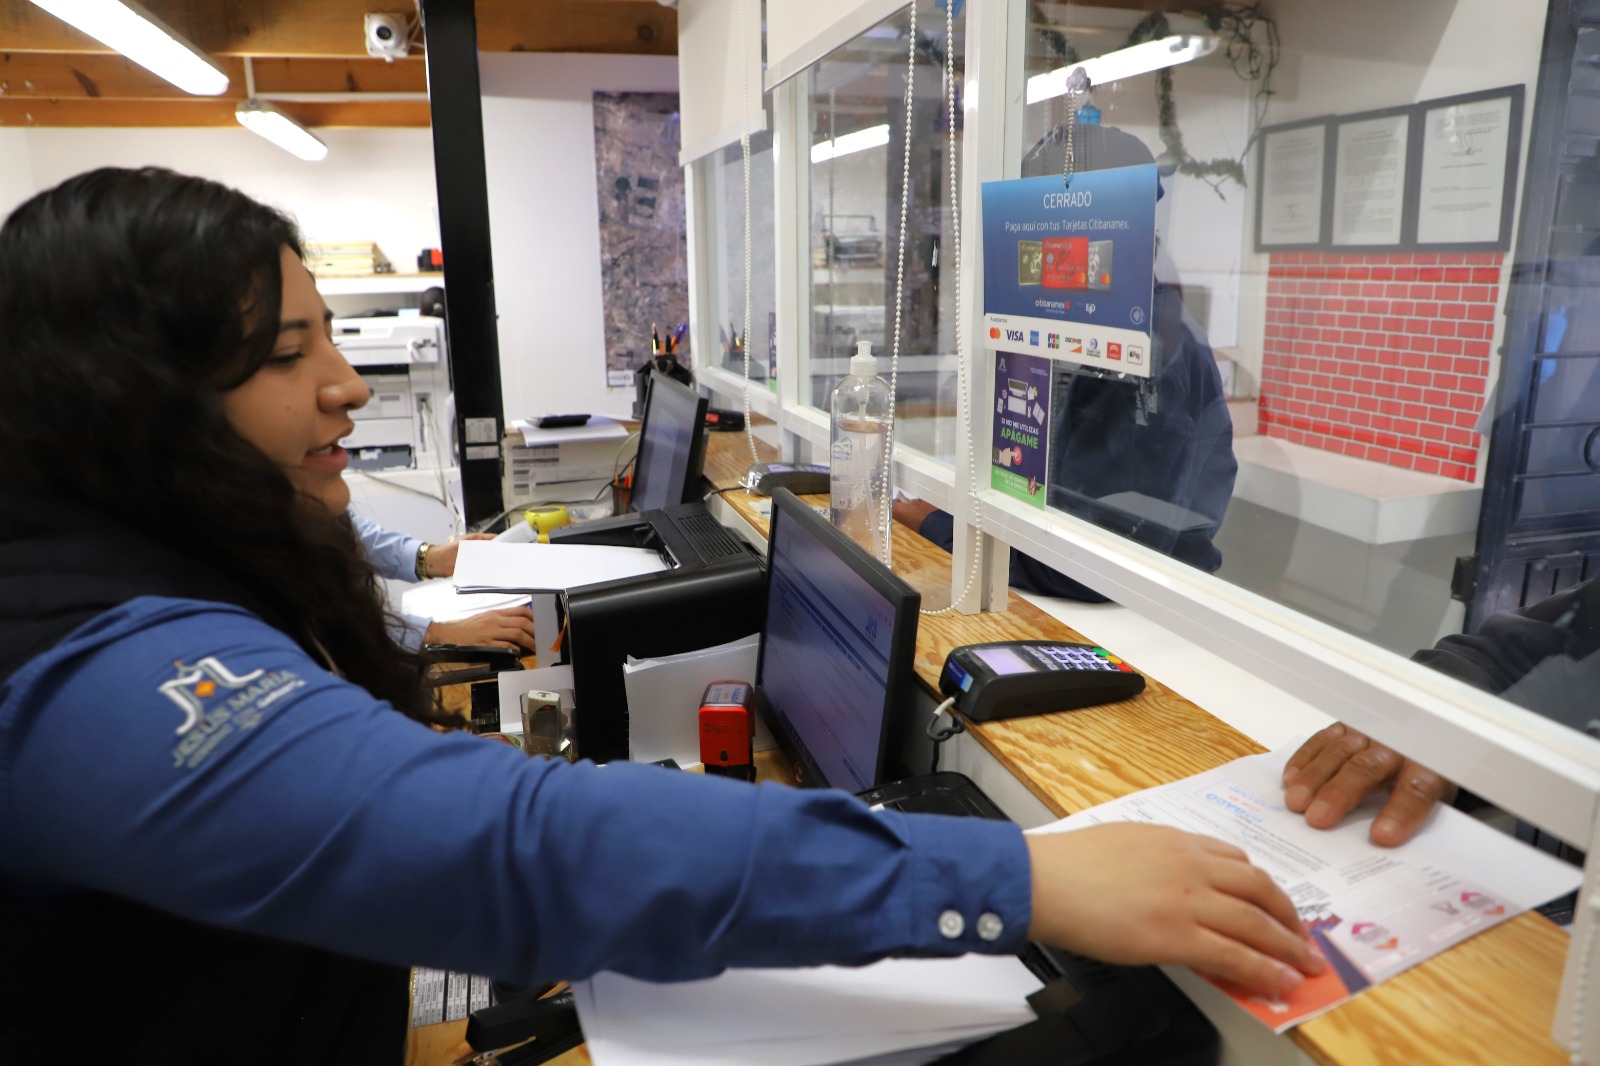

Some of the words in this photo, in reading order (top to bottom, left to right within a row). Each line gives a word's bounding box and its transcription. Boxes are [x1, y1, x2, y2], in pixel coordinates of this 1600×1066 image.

[1043, 191, 1092, 209] CERRADO
[1005, 221, 1020, 233] Paga
[1021, 220, 1036, 233] aquí
[1036, 221, 1049, 231] con
[1050, 220, 1060, 231] tus
[1062, 219, 1087, 232] Tarjetas
[1006, 329, 1024, 343] VISA
[1001, 417, 1006, 425] SI
[1006, 418, 1013, 427] NO
[1012, 420, 1020, 430] ME
[1020, 422, 1039, 435] UTILIZAS
[1001, 426, 1039, 449] APÁGAME
